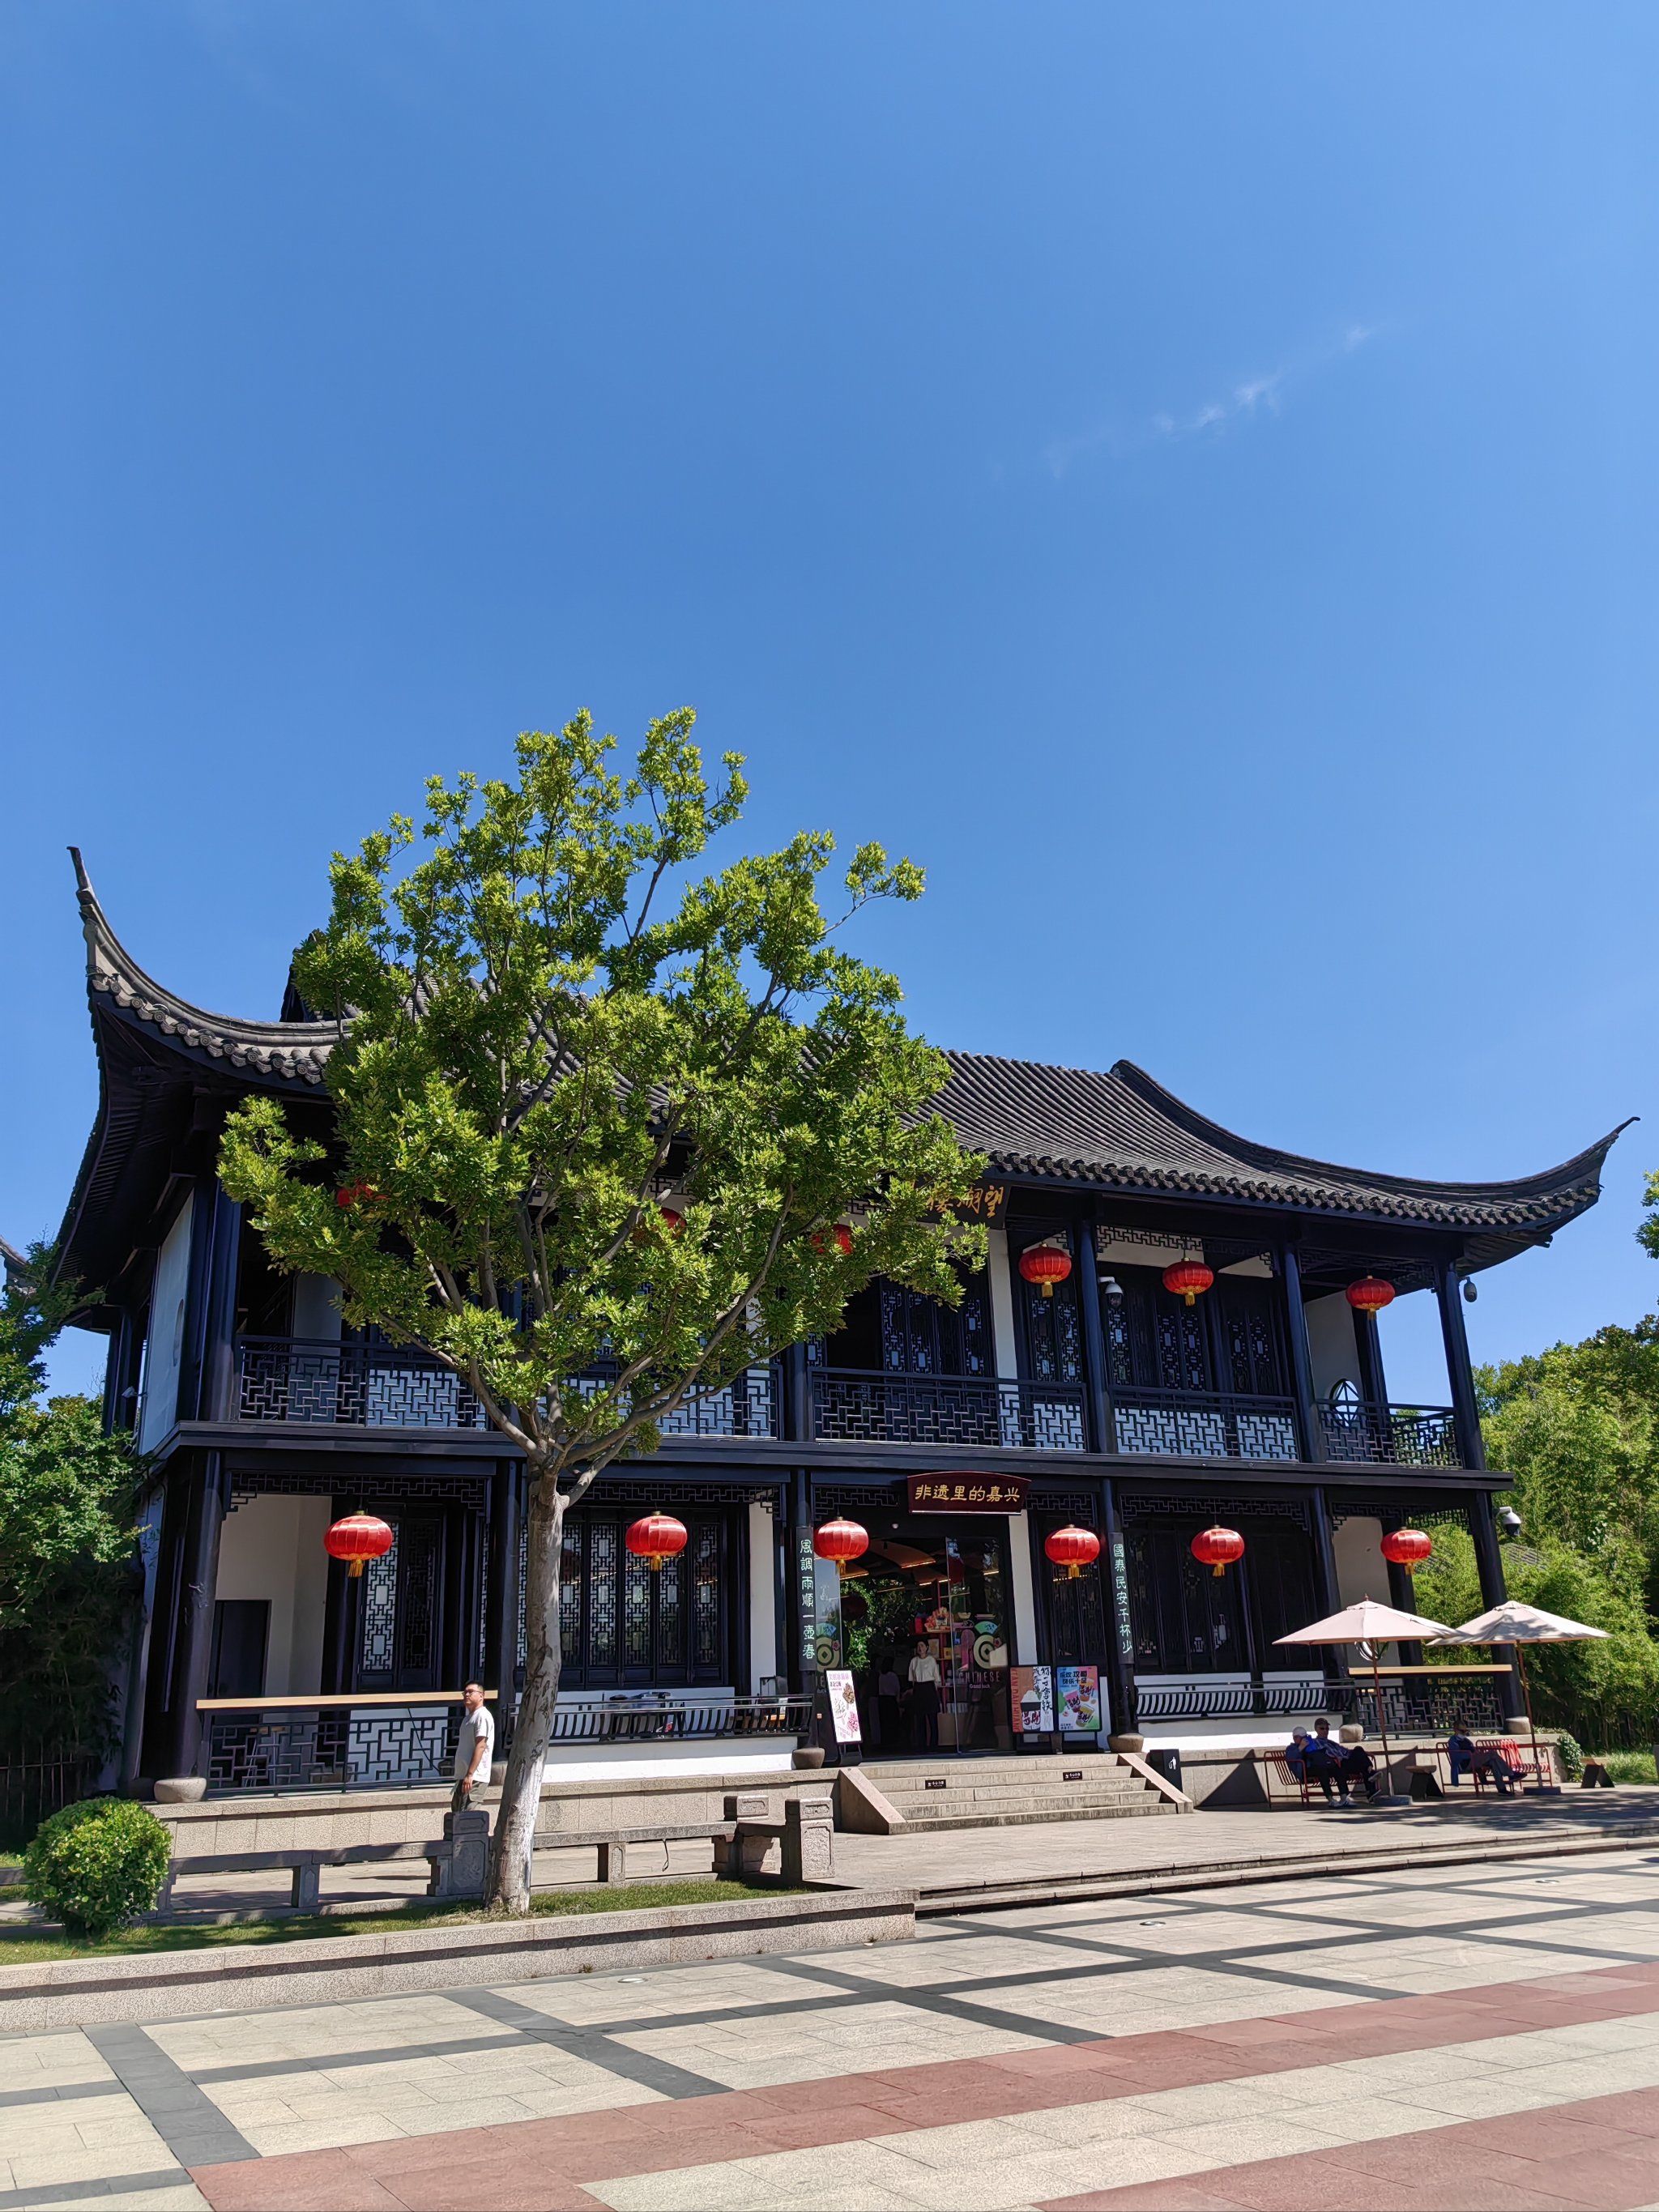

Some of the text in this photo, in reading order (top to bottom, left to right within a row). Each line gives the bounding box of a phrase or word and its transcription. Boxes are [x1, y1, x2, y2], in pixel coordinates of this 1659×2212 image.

[915, 1484, 1021, 1502] 非遗里的嘉兴
[800, 1539, 815, 1660] 風調雨順一壺春
[1113, 1544, 1132, 1654] 國泰民安千杯少
